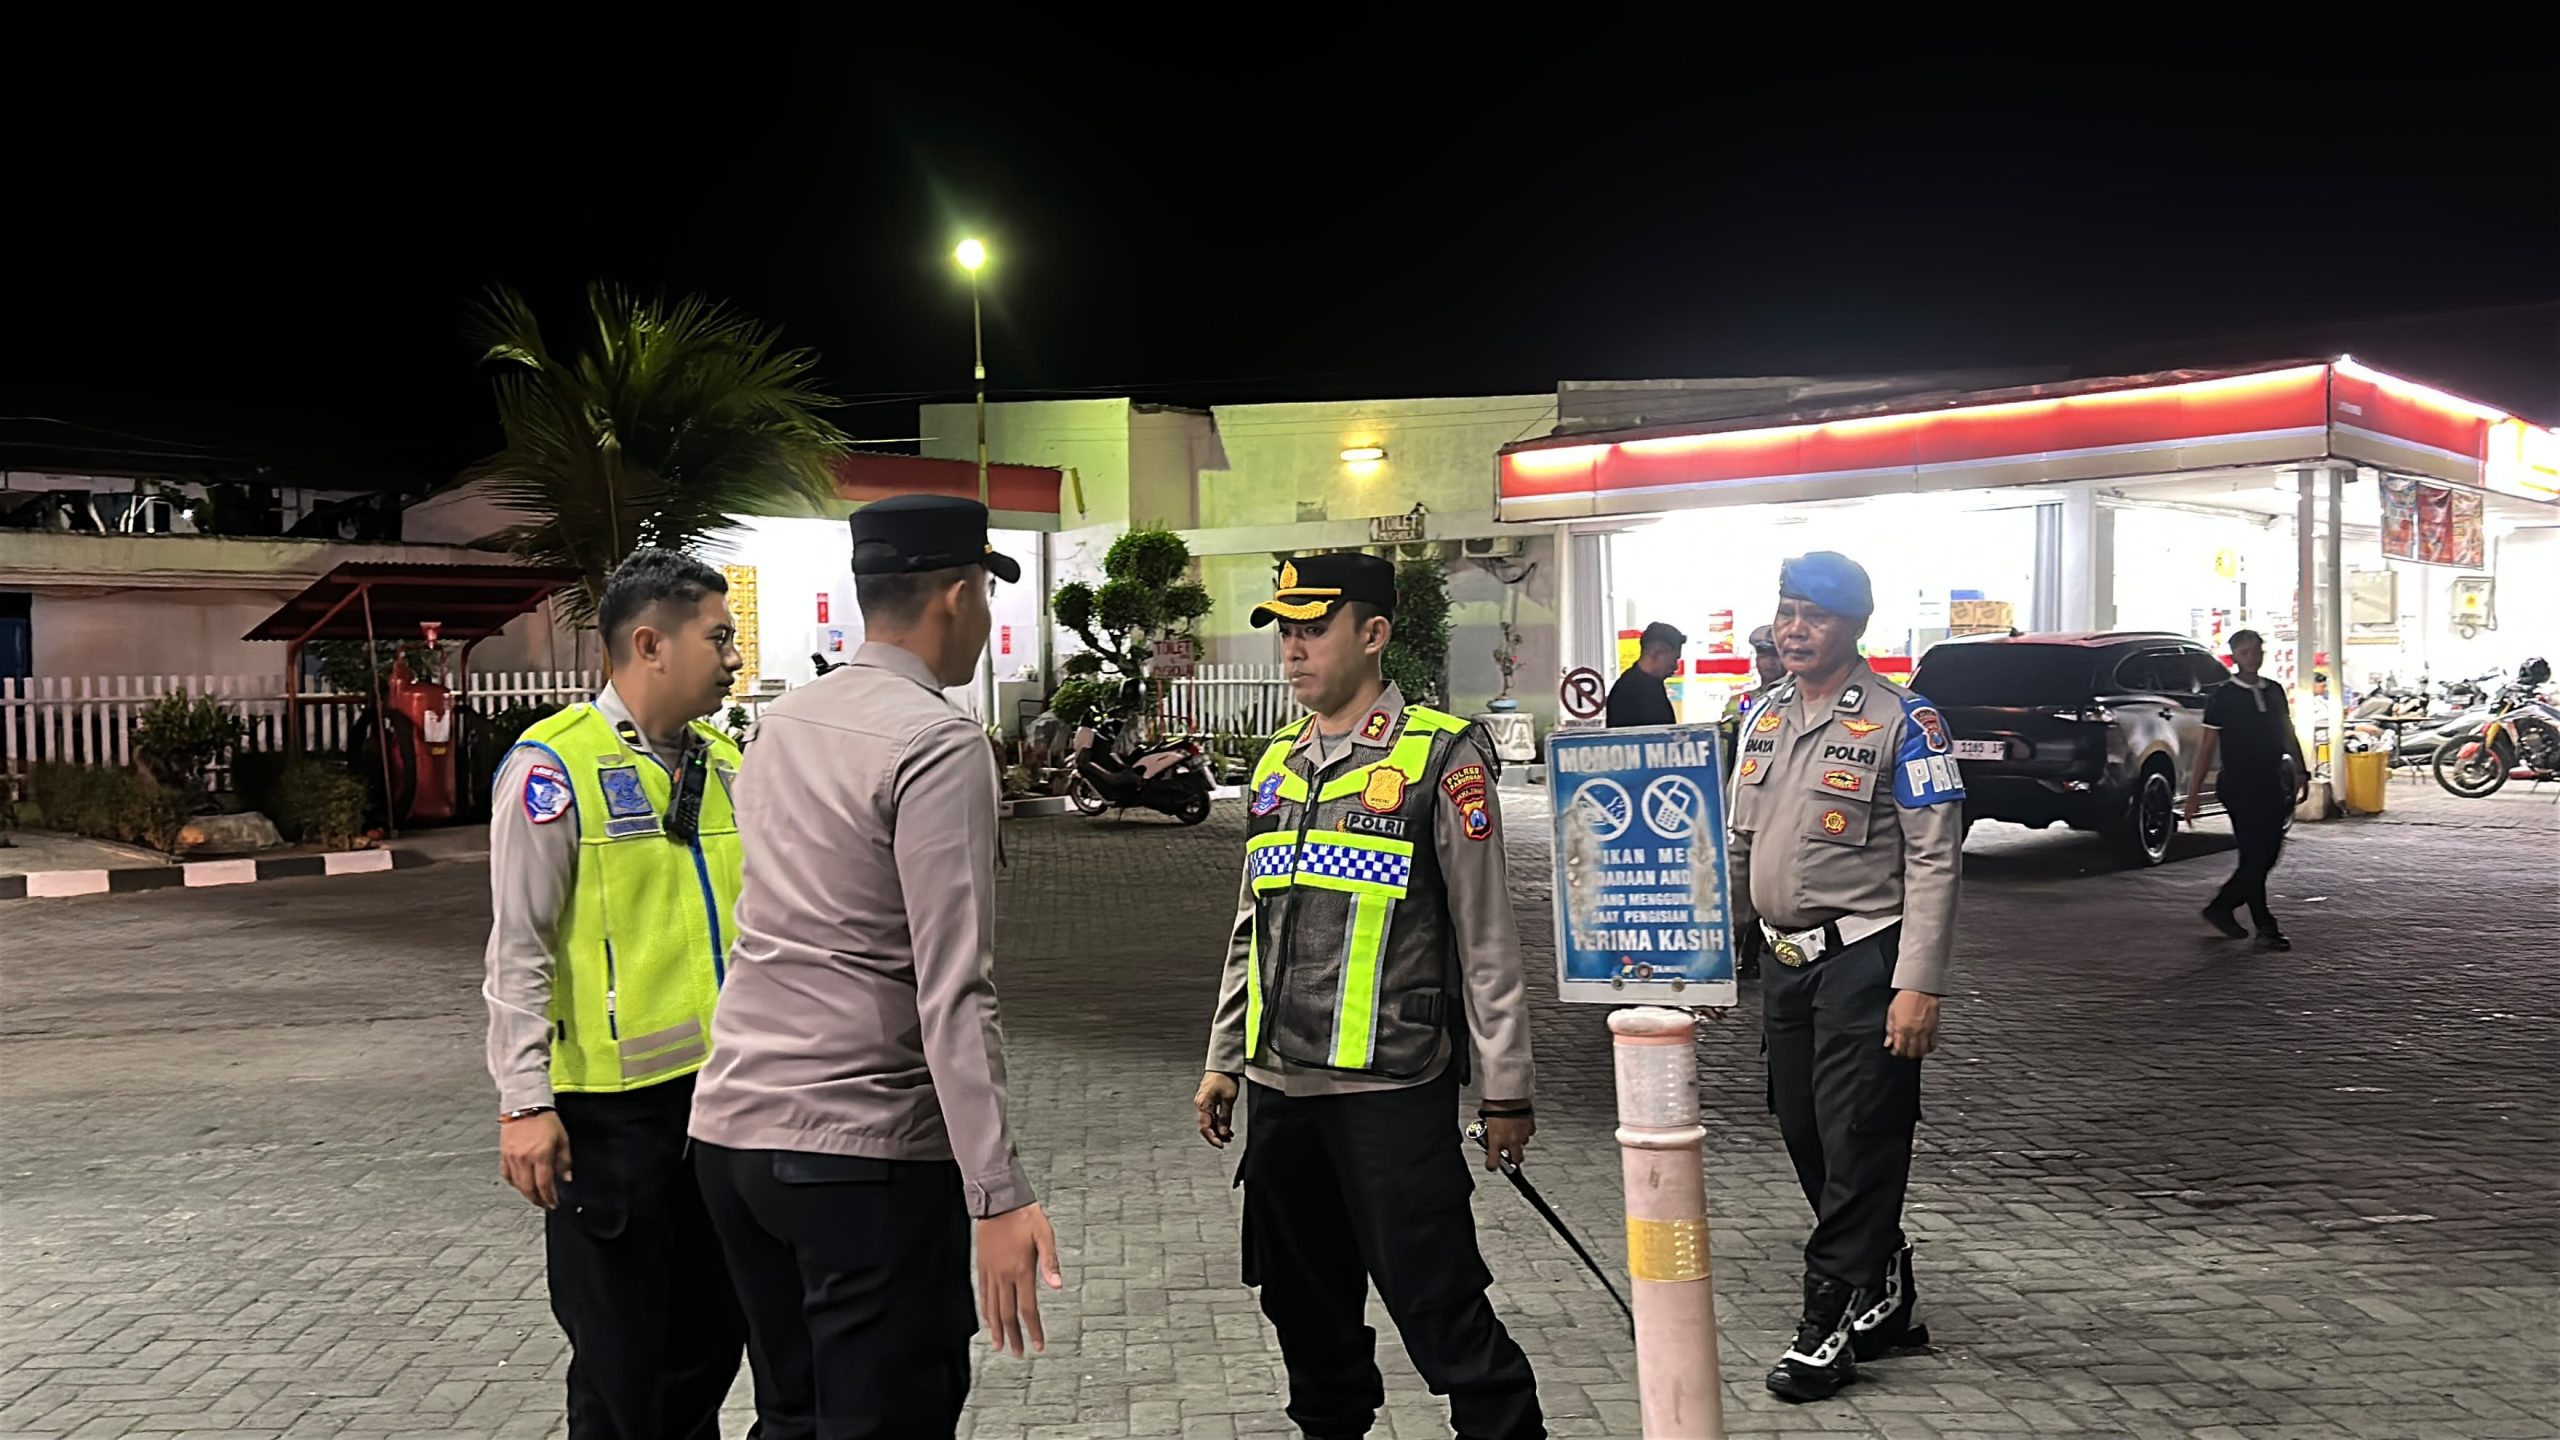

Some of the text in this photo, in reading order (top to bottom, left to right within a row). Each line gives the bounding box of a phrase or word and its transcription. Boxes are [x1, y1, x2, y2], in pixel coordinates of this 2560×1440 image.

[1645, 741, 1710, 769] MAAF
[1823, 745, 1877, 766] POLRI
[1446, 766, 1480, 785] POLRES
[1349, 815, 1402, 834] POLRI
[1571, 929, 1725, 951] TERIMA KASIH
